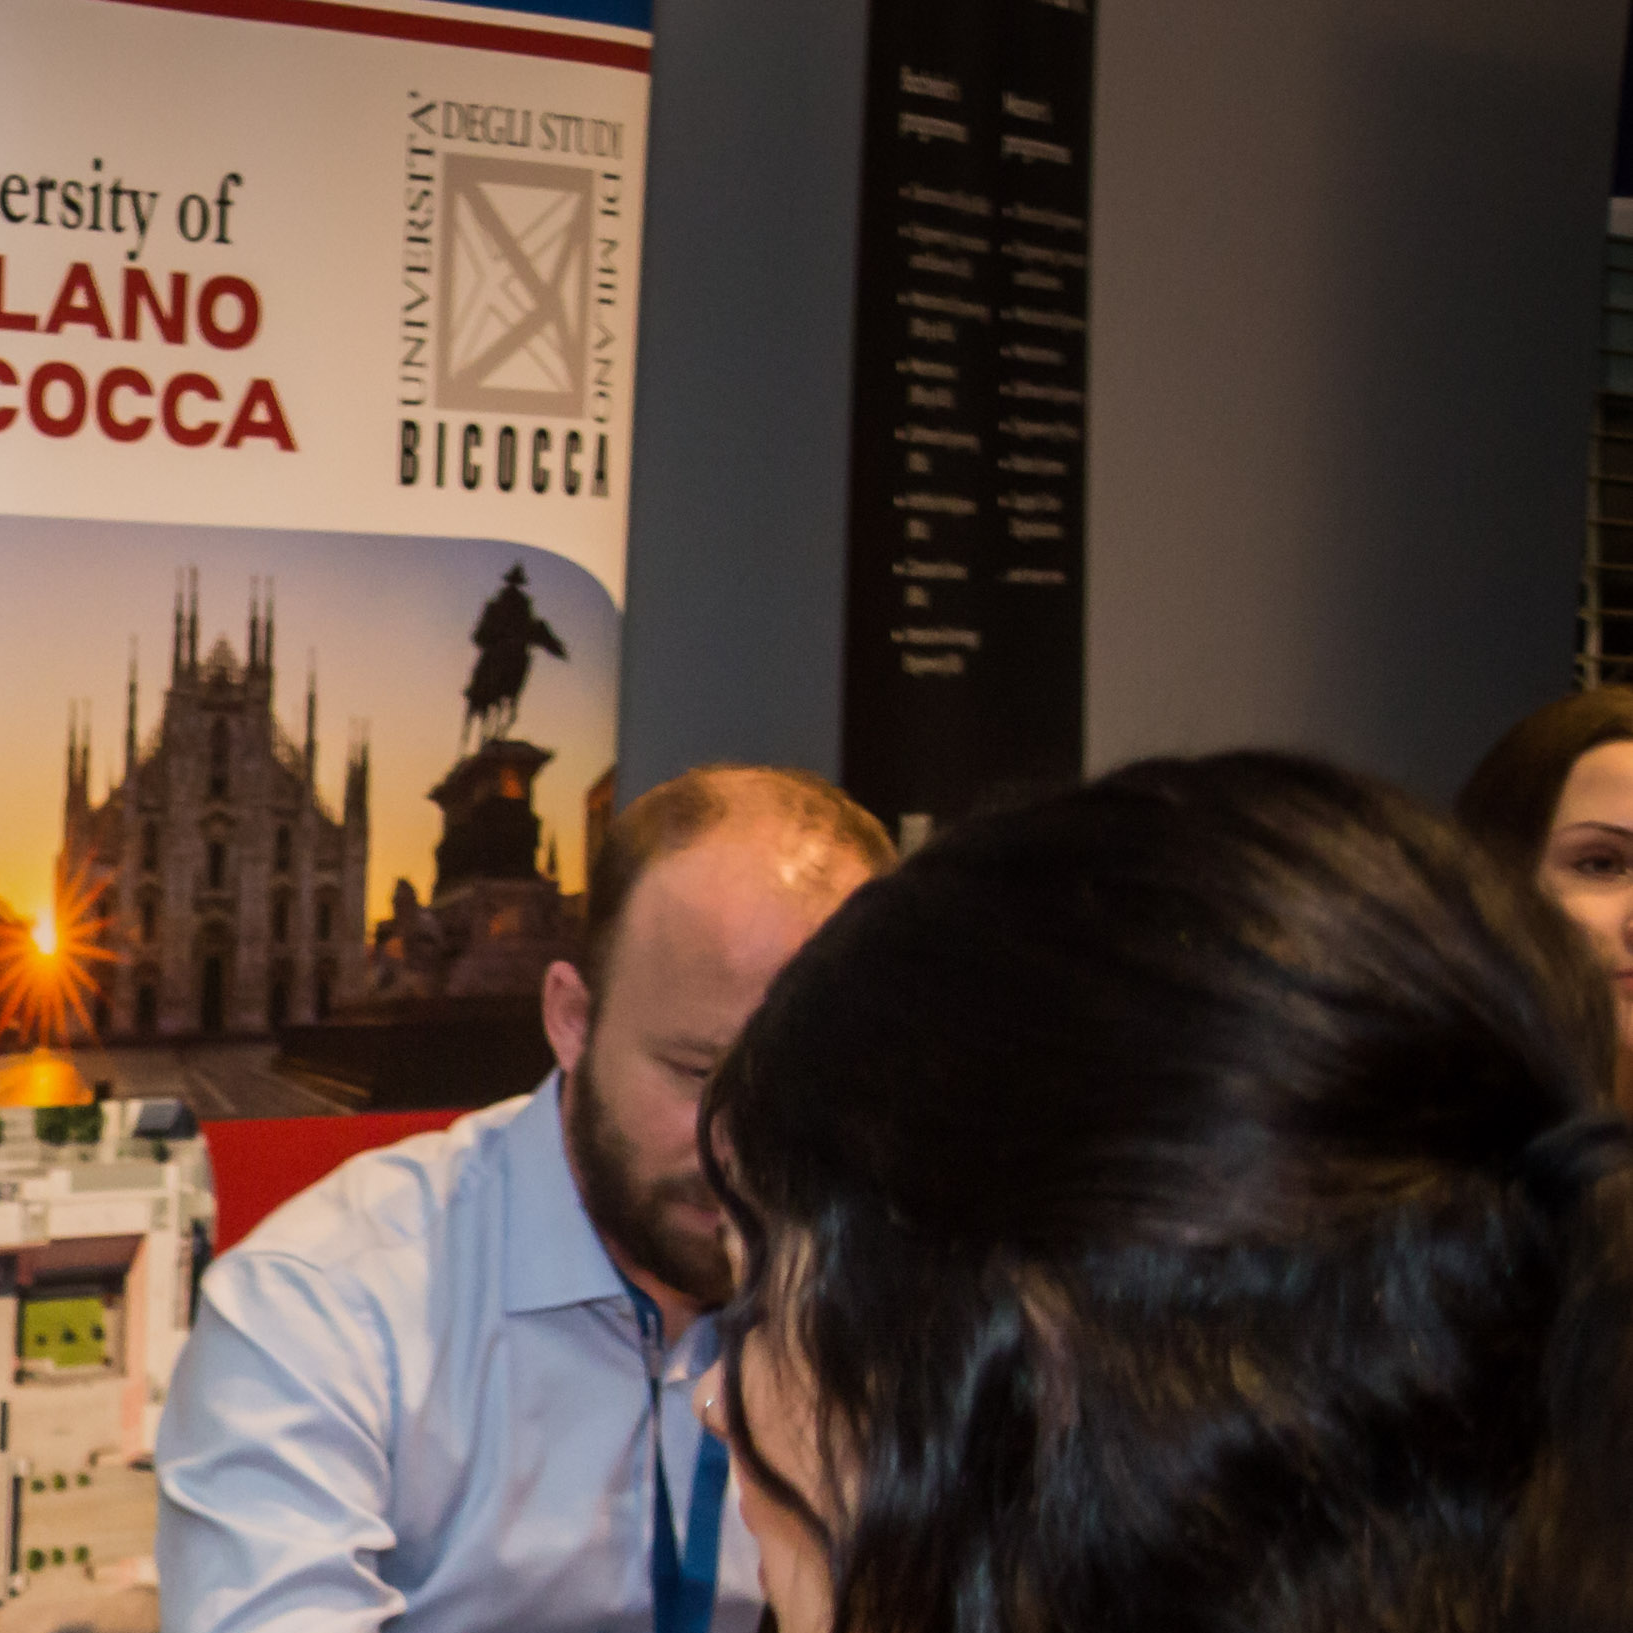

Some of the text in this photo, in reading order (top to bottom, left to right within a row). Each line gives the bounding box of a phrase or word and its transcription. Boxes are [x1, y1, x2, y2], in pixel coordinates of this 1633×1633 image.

[441, 101, 624, 160] DEGLI STUDI
[177, 172, 244, 246] of
[591, 237, 621, 424] MILANO
[398, 418, 609, 498] BICOCCA
